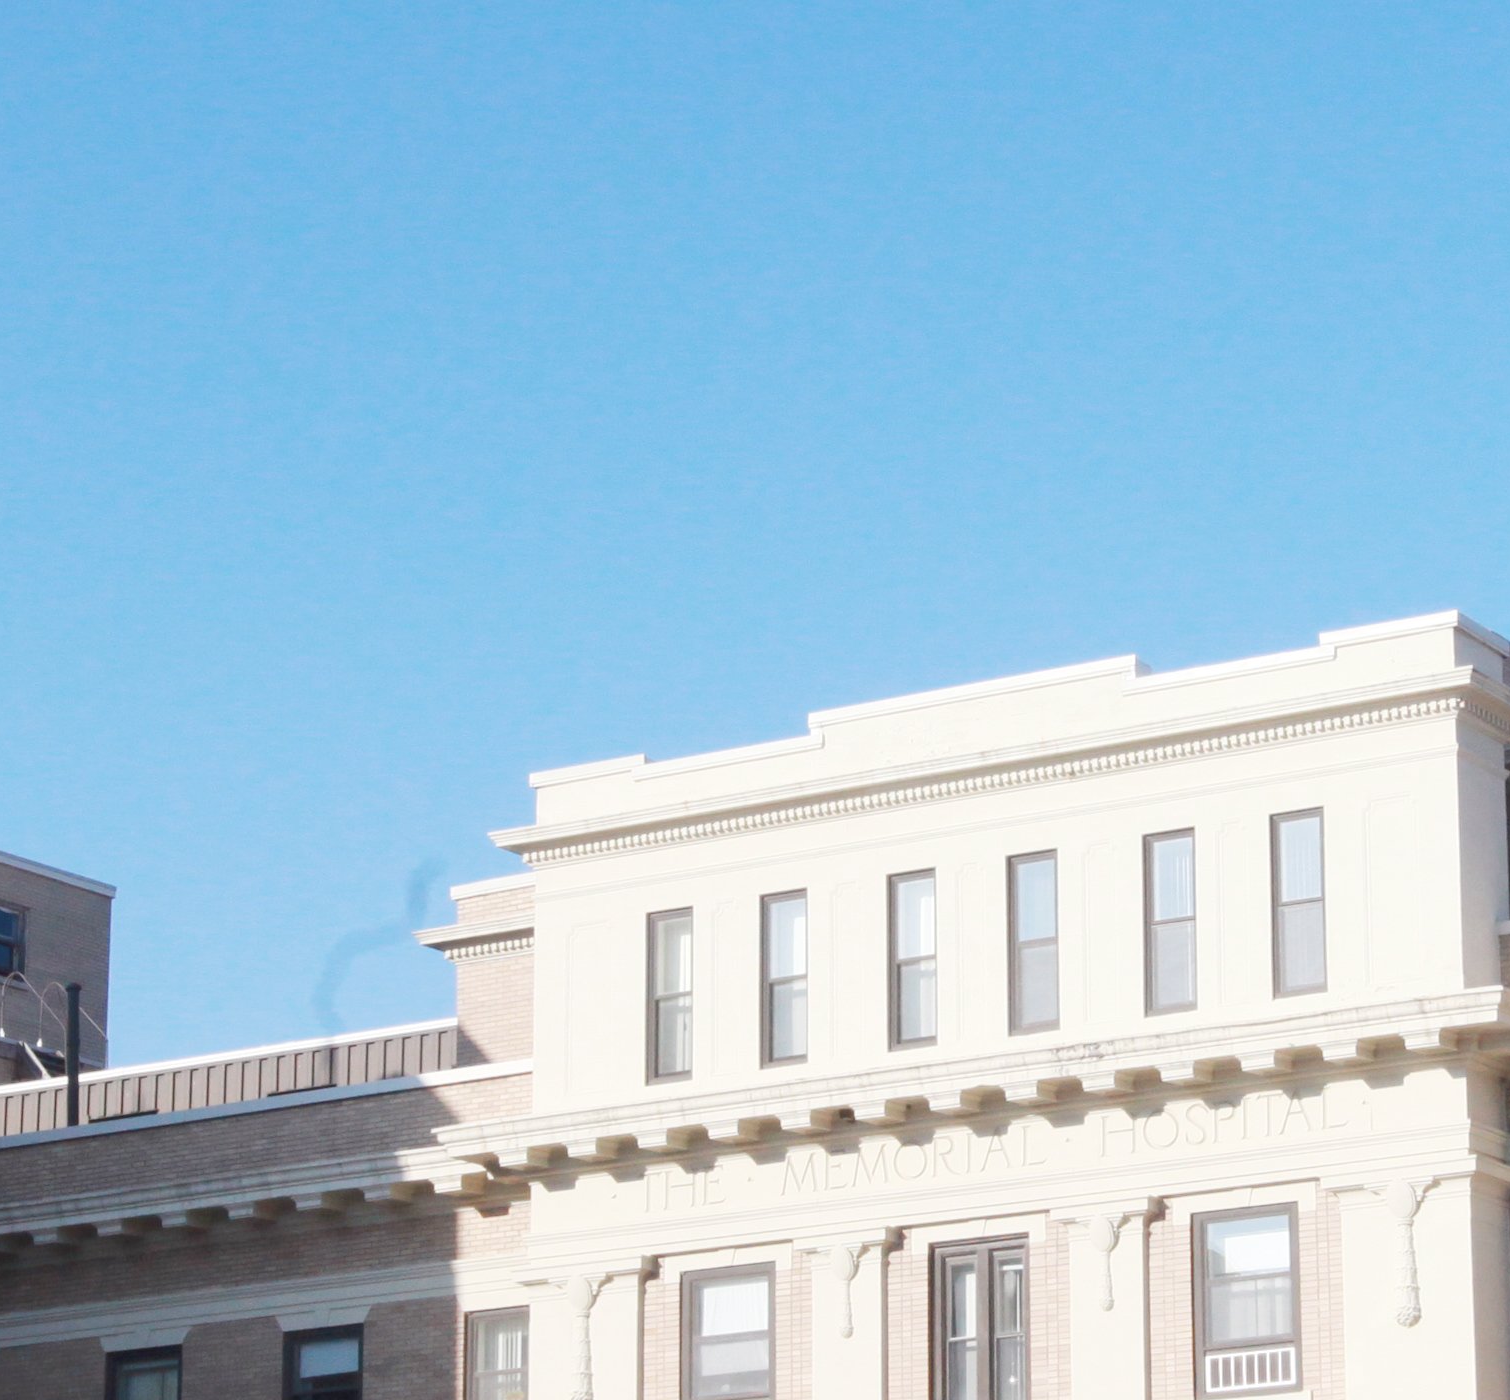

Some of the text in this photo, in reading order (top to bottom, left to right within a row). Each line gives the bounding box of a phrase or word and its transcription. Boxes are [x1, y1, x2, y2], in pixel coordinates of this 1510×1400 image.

[644, 1084, 1349, 1213] THE MEMORIAL HOSPITAL
